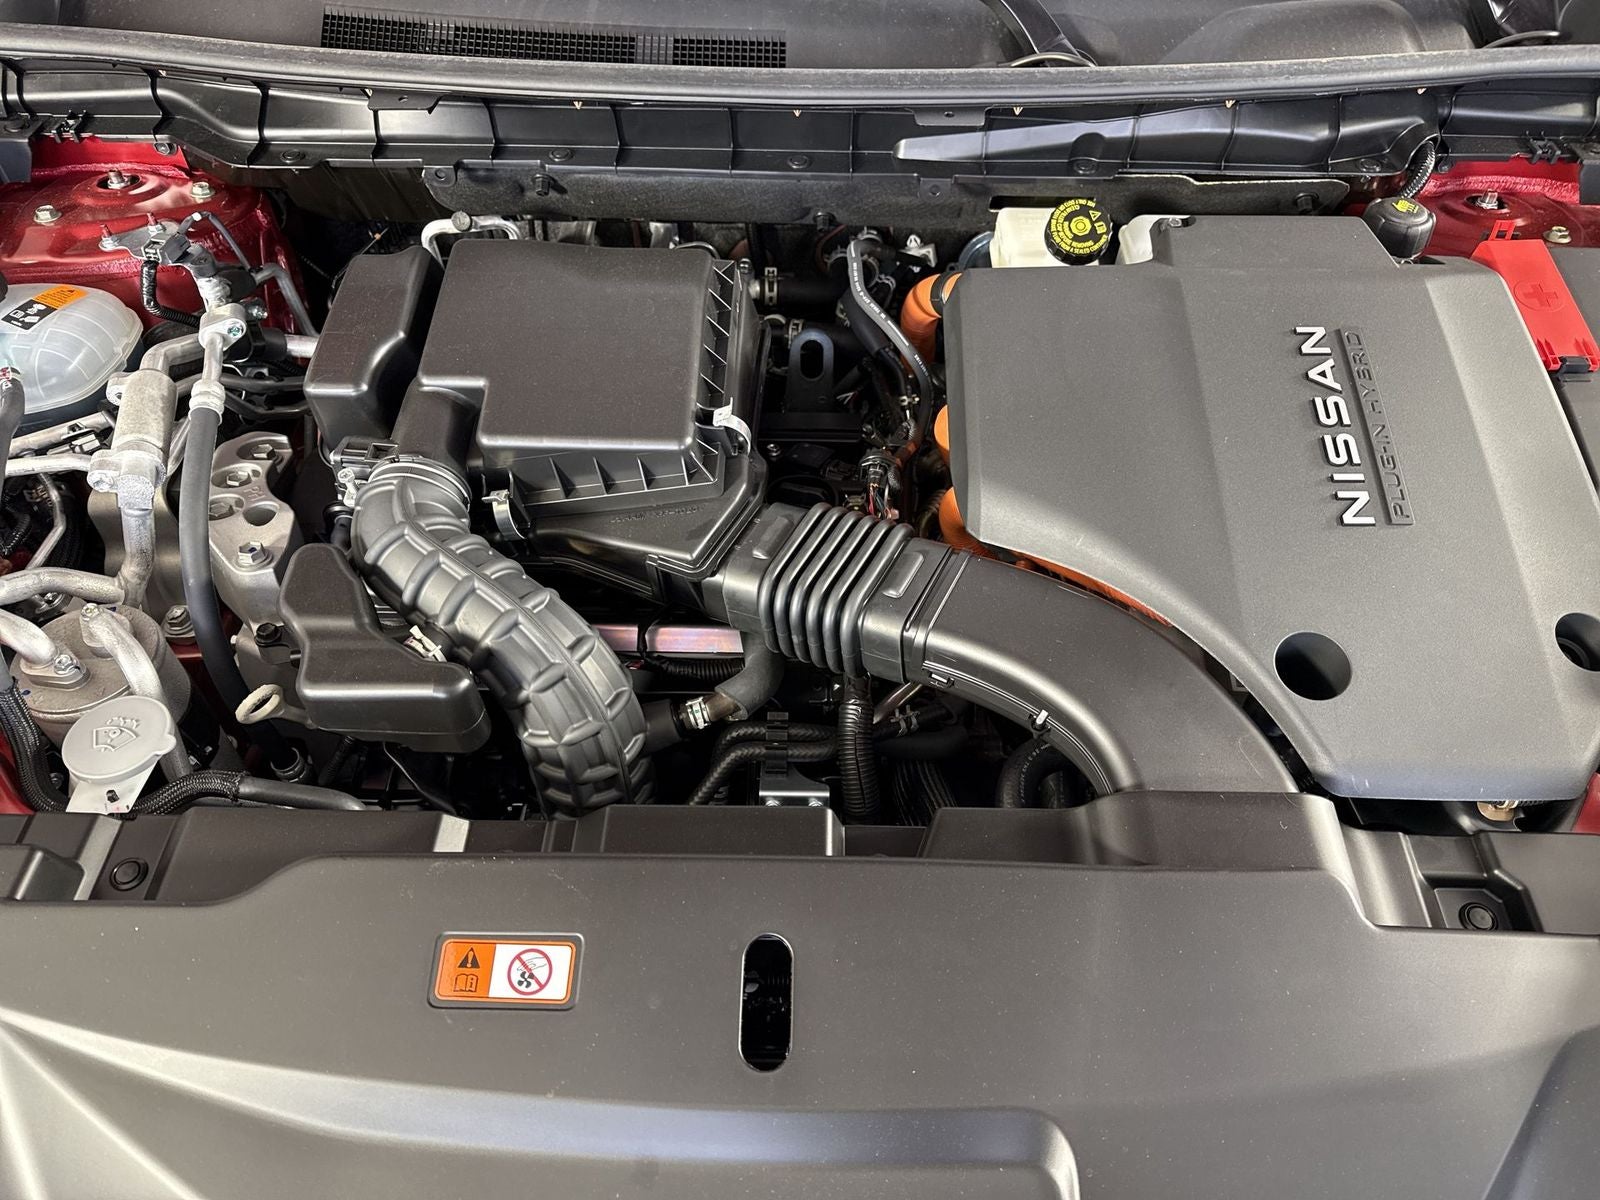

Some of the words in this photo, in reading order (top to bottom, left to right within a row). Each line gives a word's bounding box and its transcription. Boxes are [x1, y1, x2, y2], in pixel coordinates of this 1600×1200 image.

[1344, 330, 1384, 415] HYBRID
[1293, 326, 1376, 527] NISSAN
[1372, 423, 1411, 519] PLUG-IN
